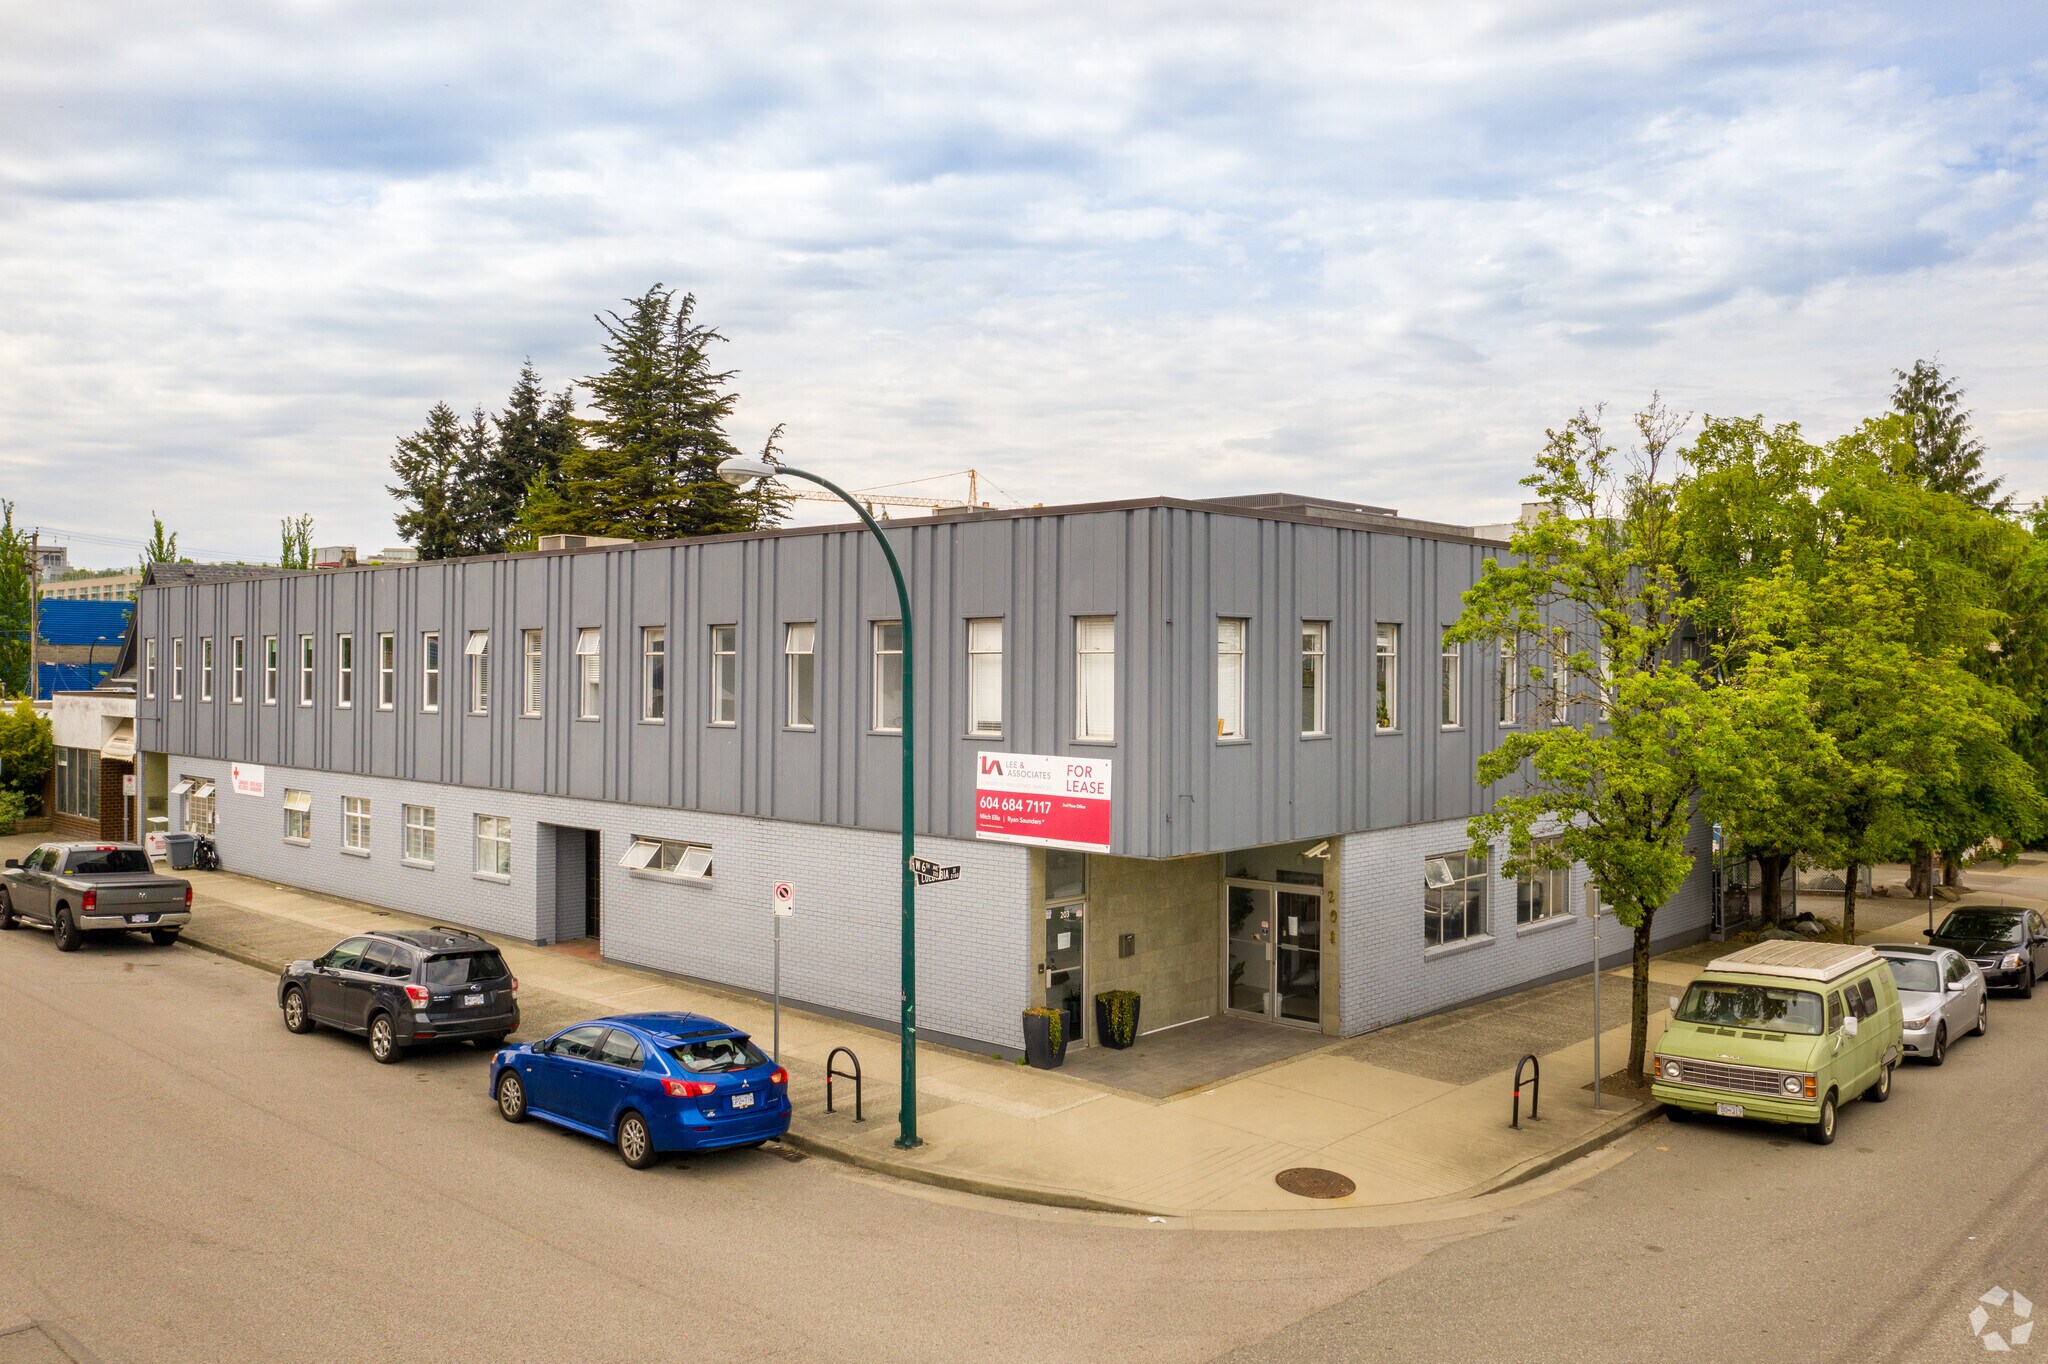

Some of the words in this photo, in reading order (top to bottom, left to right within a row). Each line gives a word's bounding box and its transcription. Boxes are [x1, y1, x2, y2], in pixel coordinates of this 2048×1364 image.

[1005, 761, 1018, 769] LEE
[1007, 769, 1051, 780] ASSOCIATES
[1066, 764, 1093, 778] FOR
[1066, 780, 1105, 795] LEASE
[979, 796, 999, 810] 604
[1001, 798, 1023, 812] 684
[1026, 800, 1052, 815] 7117
[1007, 815, 1019, 824] Ryan
[1060, 910, 1070, 919] 203
